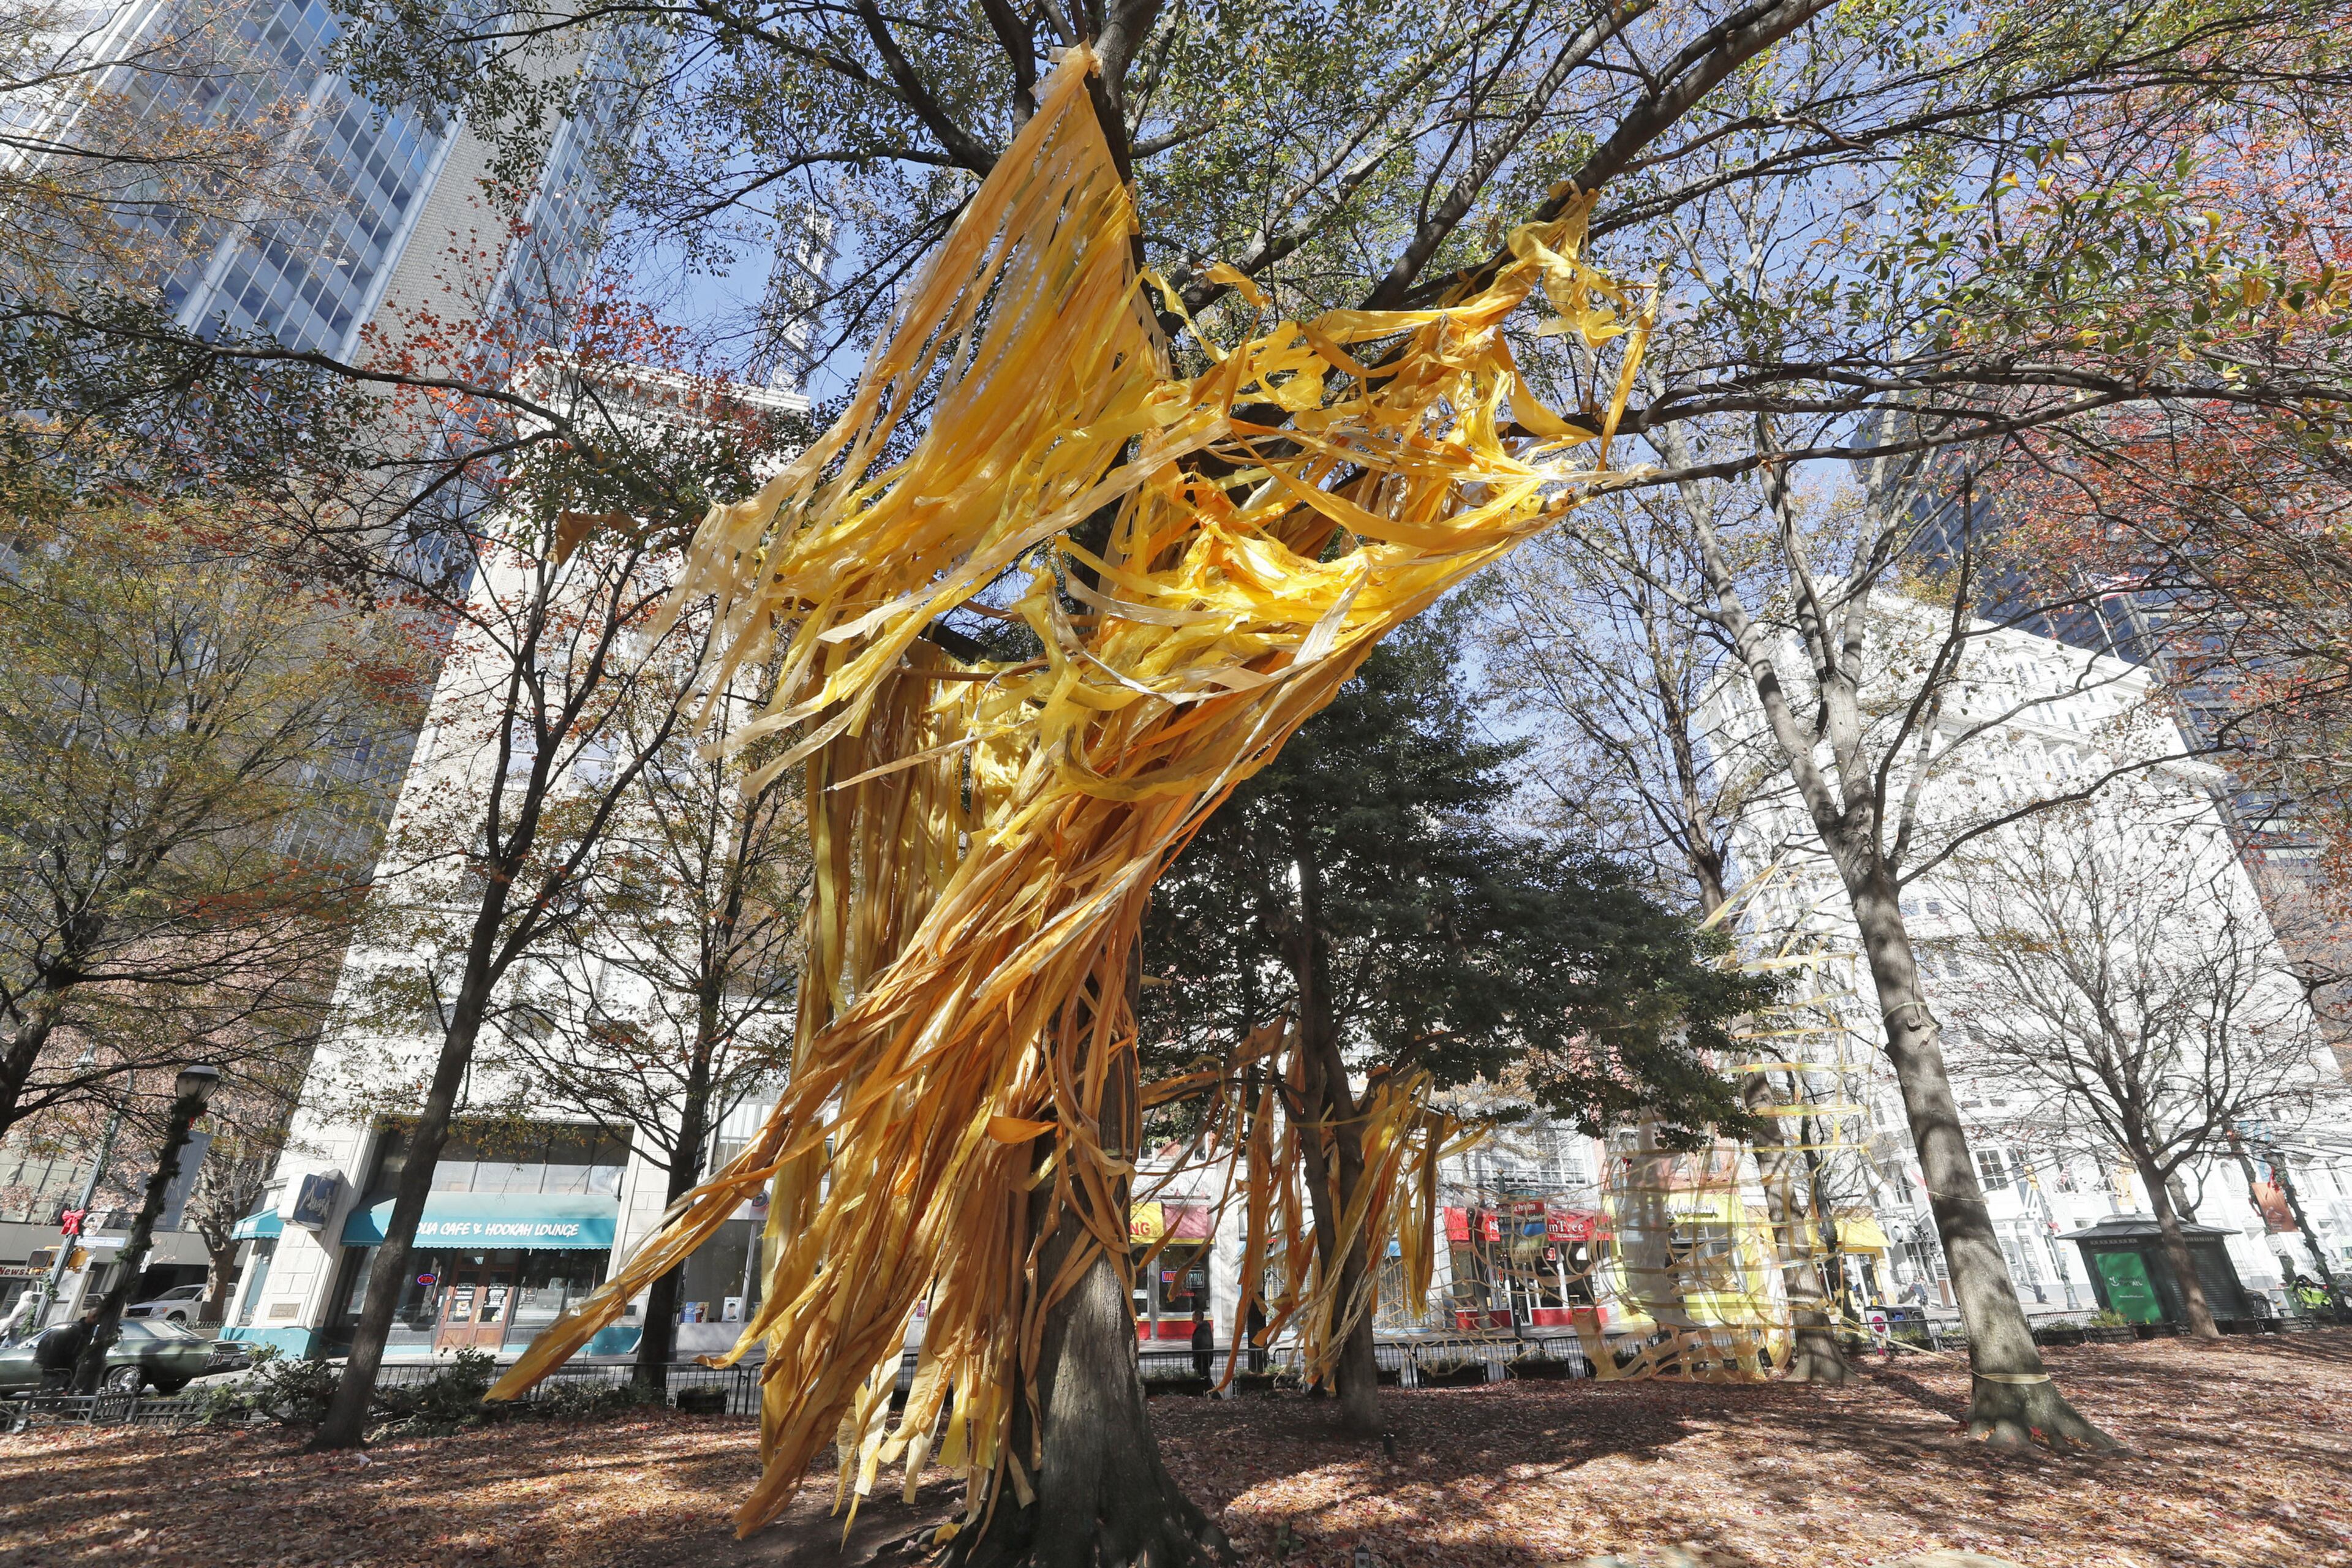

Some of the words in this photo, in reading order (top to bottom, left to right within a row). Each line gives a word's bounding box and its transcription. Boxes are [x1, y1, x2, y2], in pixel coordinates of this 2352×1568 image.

[439, 1223, 470, 1235] CAFE
[473, 1223, 482, 1235] &
[484, 1223, 532, 1237] HOOKAH
[534, 1223, 579, 1237] LOUNGE
[1129, 1221, 1151, 1235] NG
